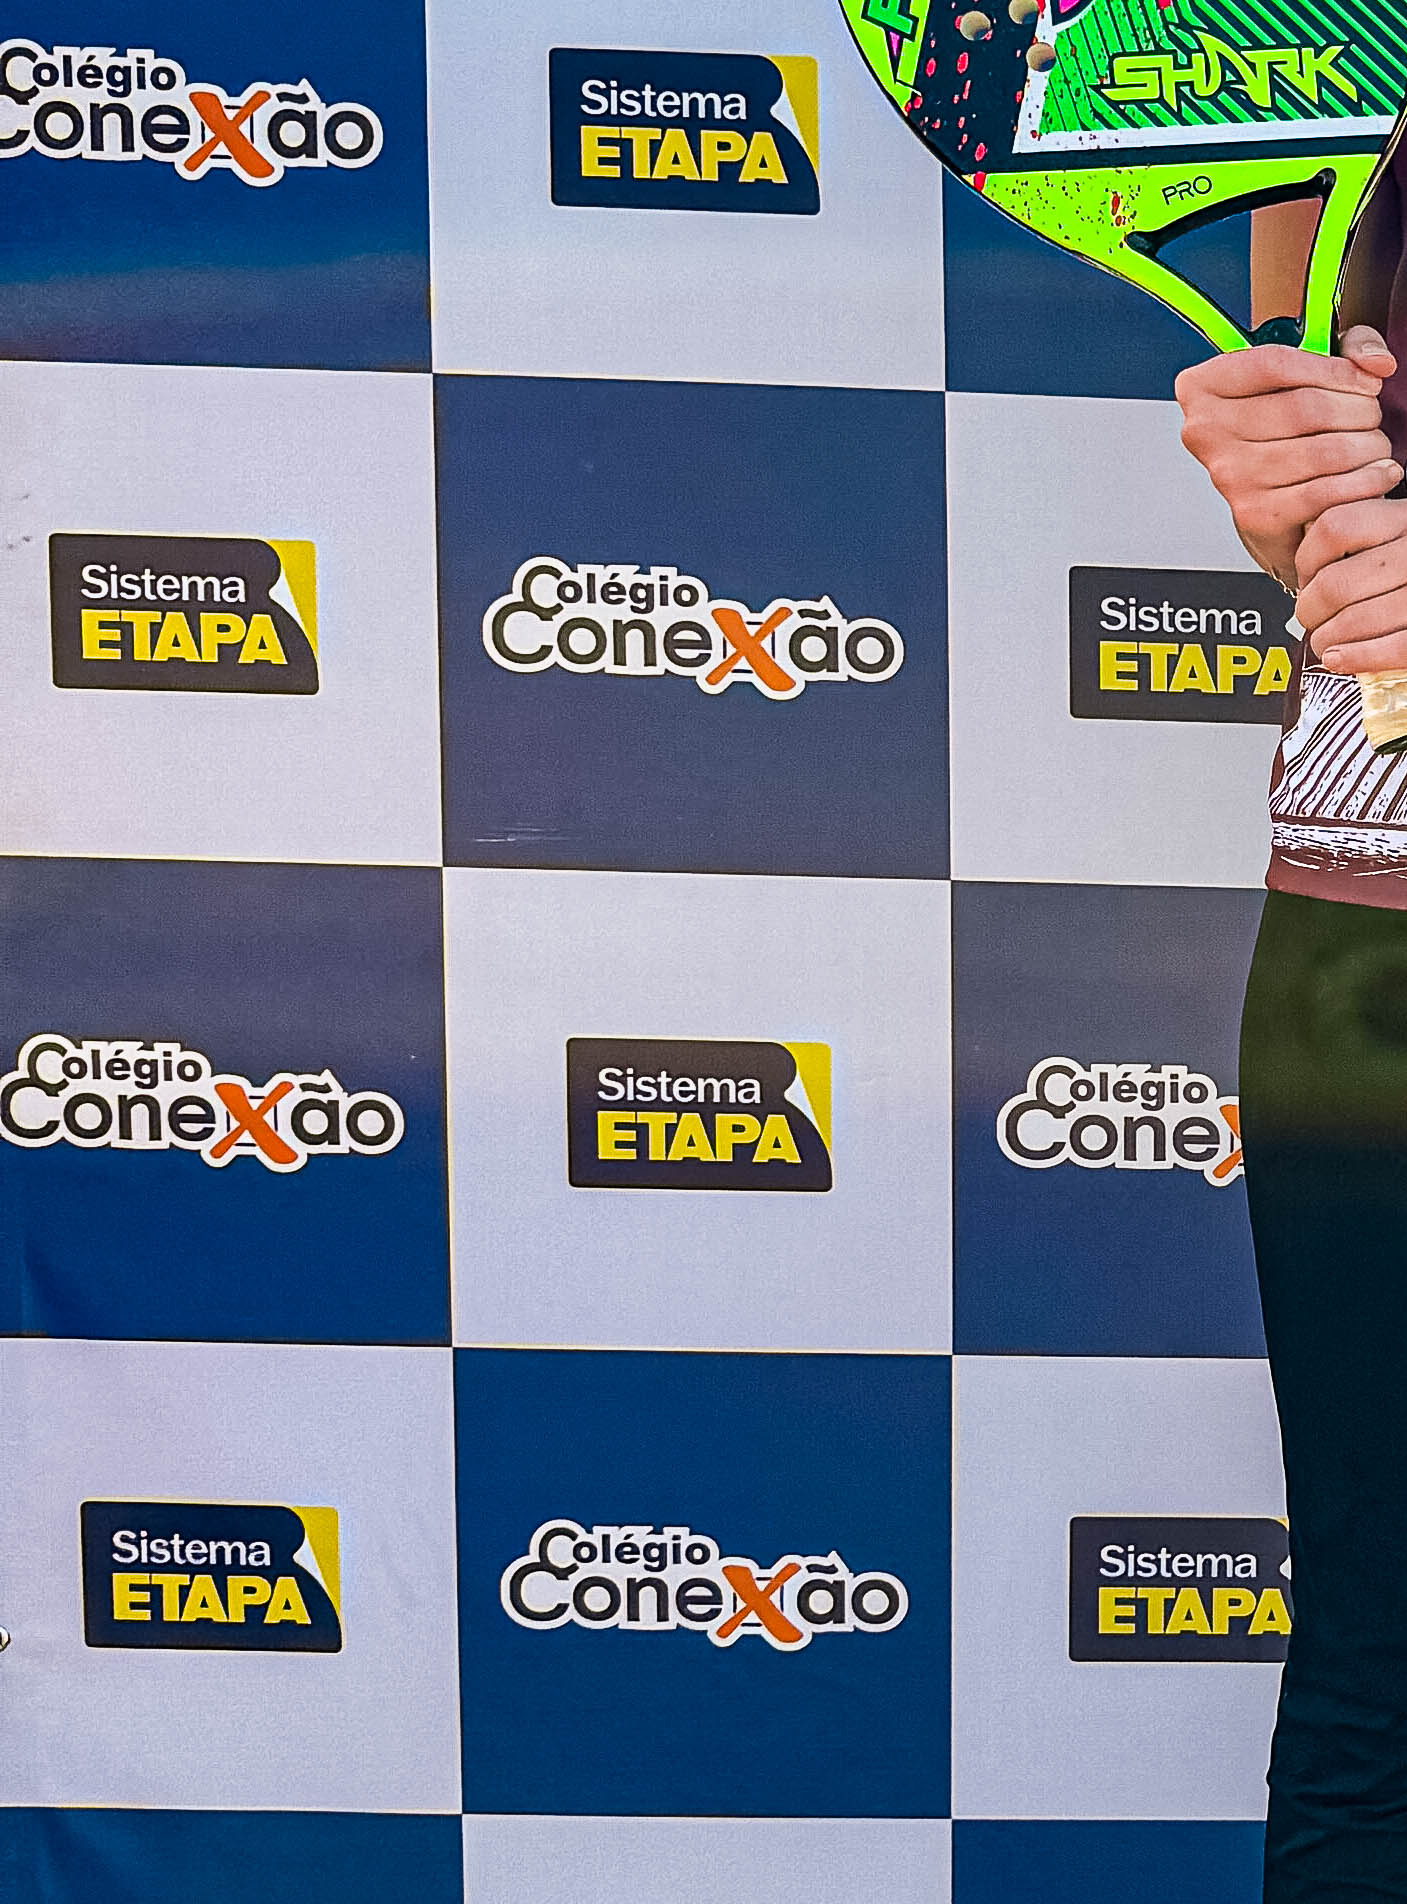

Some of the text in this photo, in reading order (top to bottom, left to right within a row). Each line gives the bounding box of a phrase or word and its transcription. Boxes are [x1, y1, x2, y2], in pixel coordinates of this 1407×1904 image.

[0, 45, 178, 95] Colégio
[1101, 30, 1357, 111] SHARK
[581, 79, 747, 119] Sistema
[580, 127, 789, 183] ETAPA
[1162, 175, 1212, 205] PRO
[81, 565, 246, 605] Sistema
[525, 562, 701, 614] Colégio
[81, 612, 287, 665] ETAPA
[1099, 597, 1263, 635] Sistema
[20, 1040, 203, 1093] Colégio
[598, 1066, 761, 1106] Sistema
[1038, 1062, 1211, 1113] Colégio
[597, 1112, 802, 1163] ETAPA
[114, 1530, 271, 1569] Sistema
[539, 1524, 711, 1570] Colégio
[1100, 1544, 1257, 1581] Sistema
[114, 1575, 312, 1624] ETAPA
[1098, 1588, 1292, 1636] ETAPA
